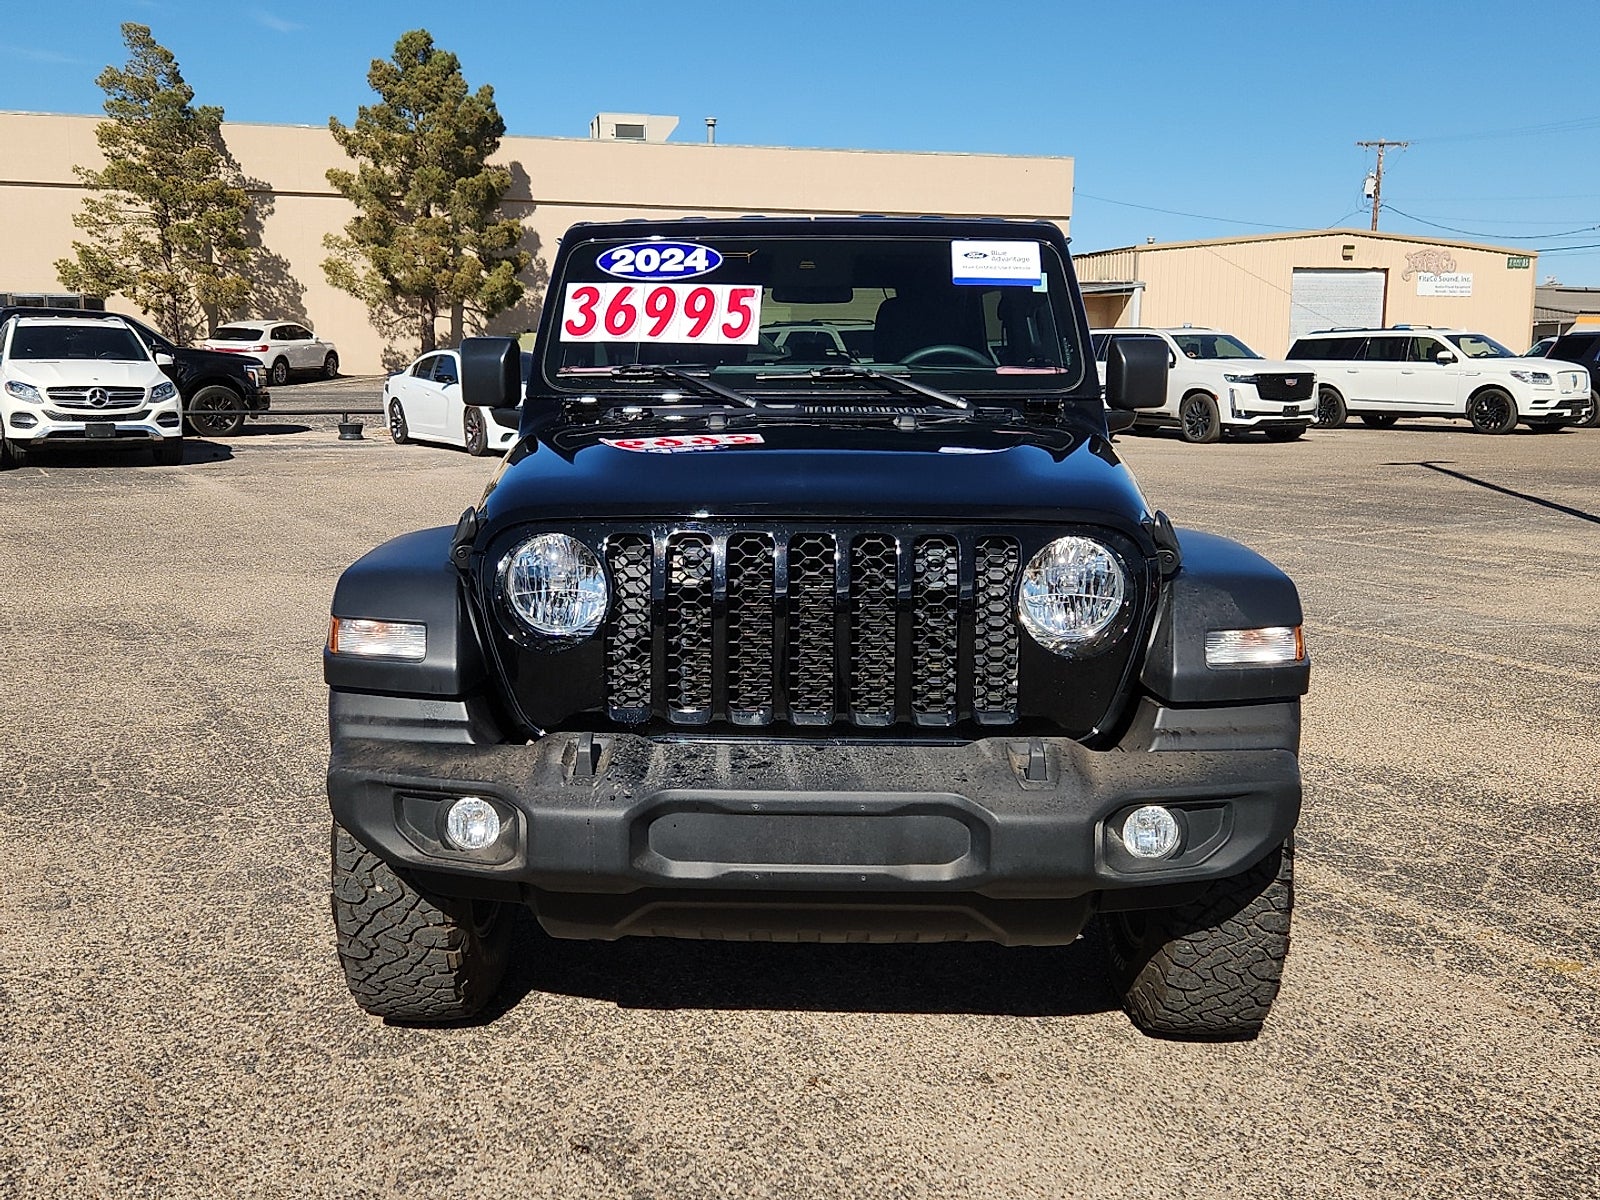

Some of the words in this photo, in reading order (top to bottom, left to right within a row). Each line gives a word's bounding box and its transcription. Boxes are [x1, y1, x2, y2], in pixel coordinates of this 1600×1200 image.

[609, 248, 709, 272] 2024
[991, 256, 1031, 264] Advantage
[564, 286, 757, 340] 36995
